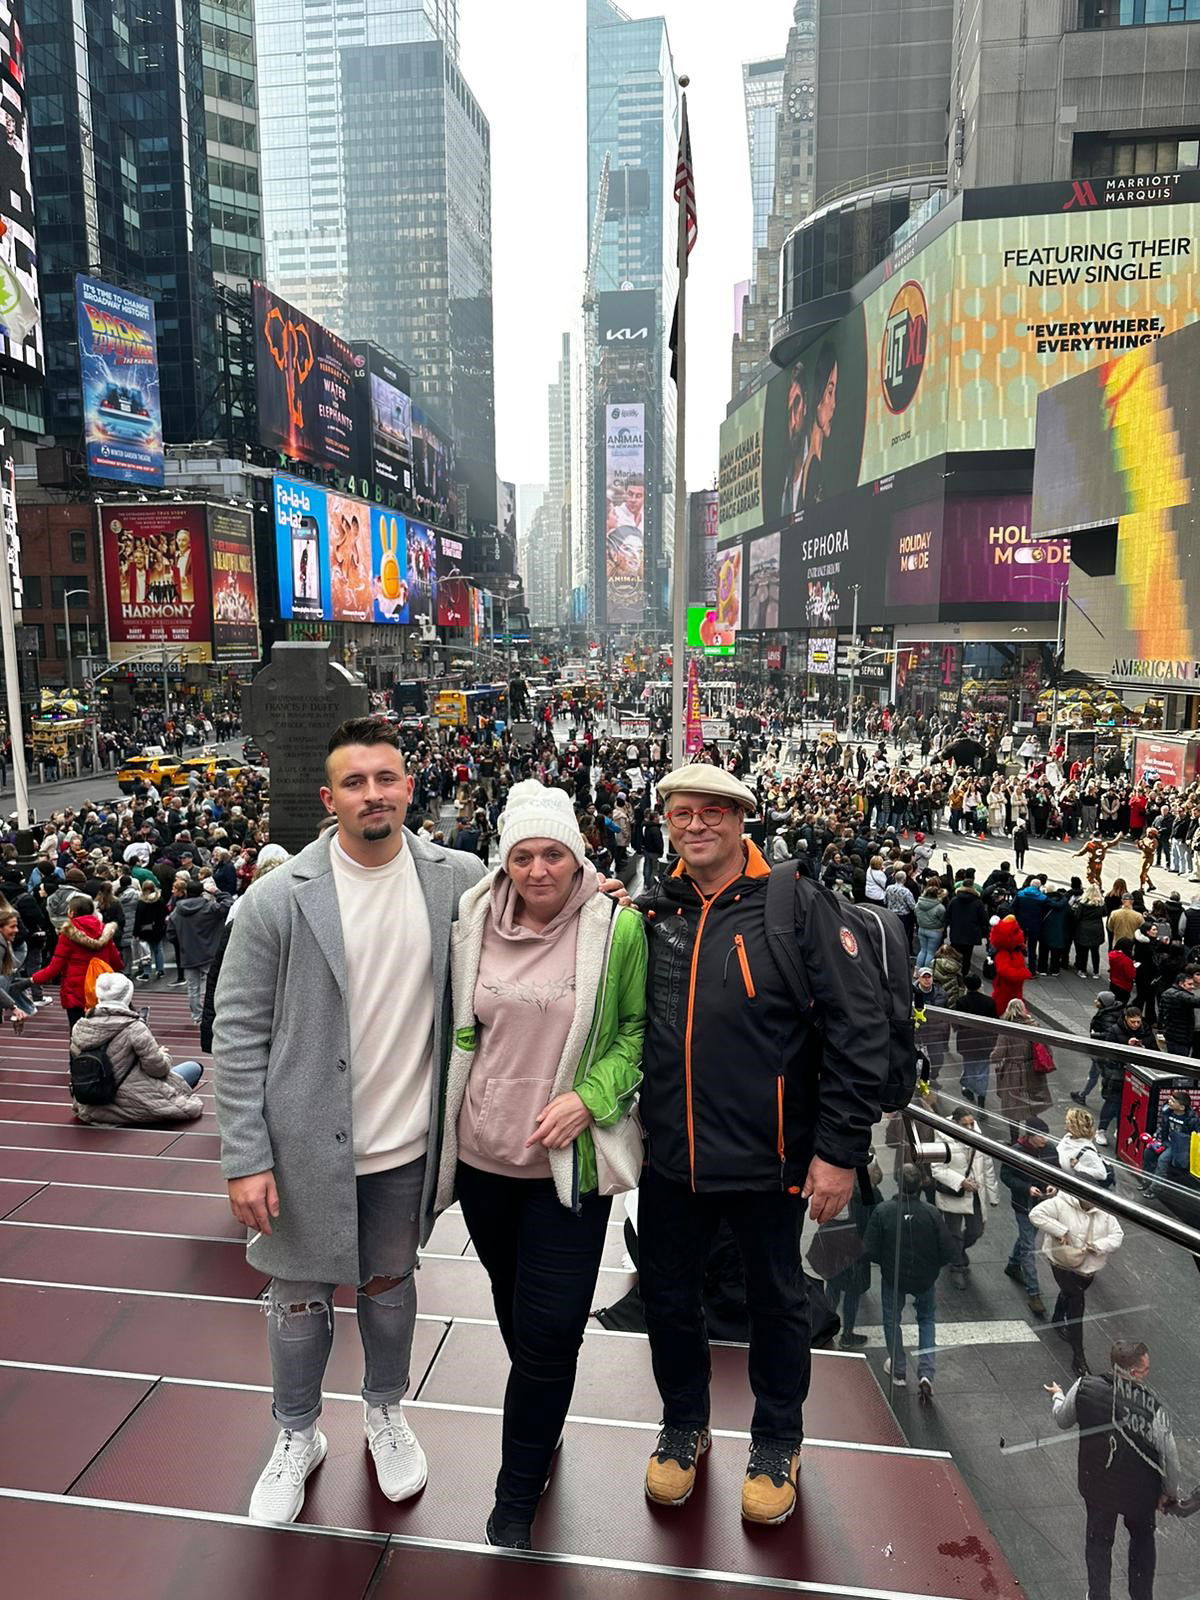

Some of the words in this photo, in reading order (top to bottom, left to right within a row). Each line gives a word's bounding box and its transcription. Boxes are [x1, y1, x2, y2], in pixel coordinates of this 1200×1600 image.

[1106, 174, 1180, 190] MARRIOTT
[1105, 188, 1171, 203] MARQUIS
[1004, 242, 1122, 267] FEATURING
[1127, 237, 1191, 258] THEIR
[1029, 267, 1080, 287] NEW
[1085, 261, 1162, 284] SINGLE
[113, 294, 122, 303] TO
[1027, 318, 1166, 338] "EVERYWHERE,
[354, 369, 365, 378] LG
[324, 378, 347, 402] WATER
[319, 403, 353, 432] ELEPHANTS
[608, 435, 643, 444] ANIMAL
[276, 484, 310, 511] Fa-la-la
[278, 504, 303, 528] la-la?
[802, 529, 849, 561] SEPHORA
[900, 531, 931, 554] HOLIDAY
[122, 604, 195, 618] HARMONY
[128, 663, 184, 673] LUGGGE
[1112, 658, 1190, 680] AMERICAN
